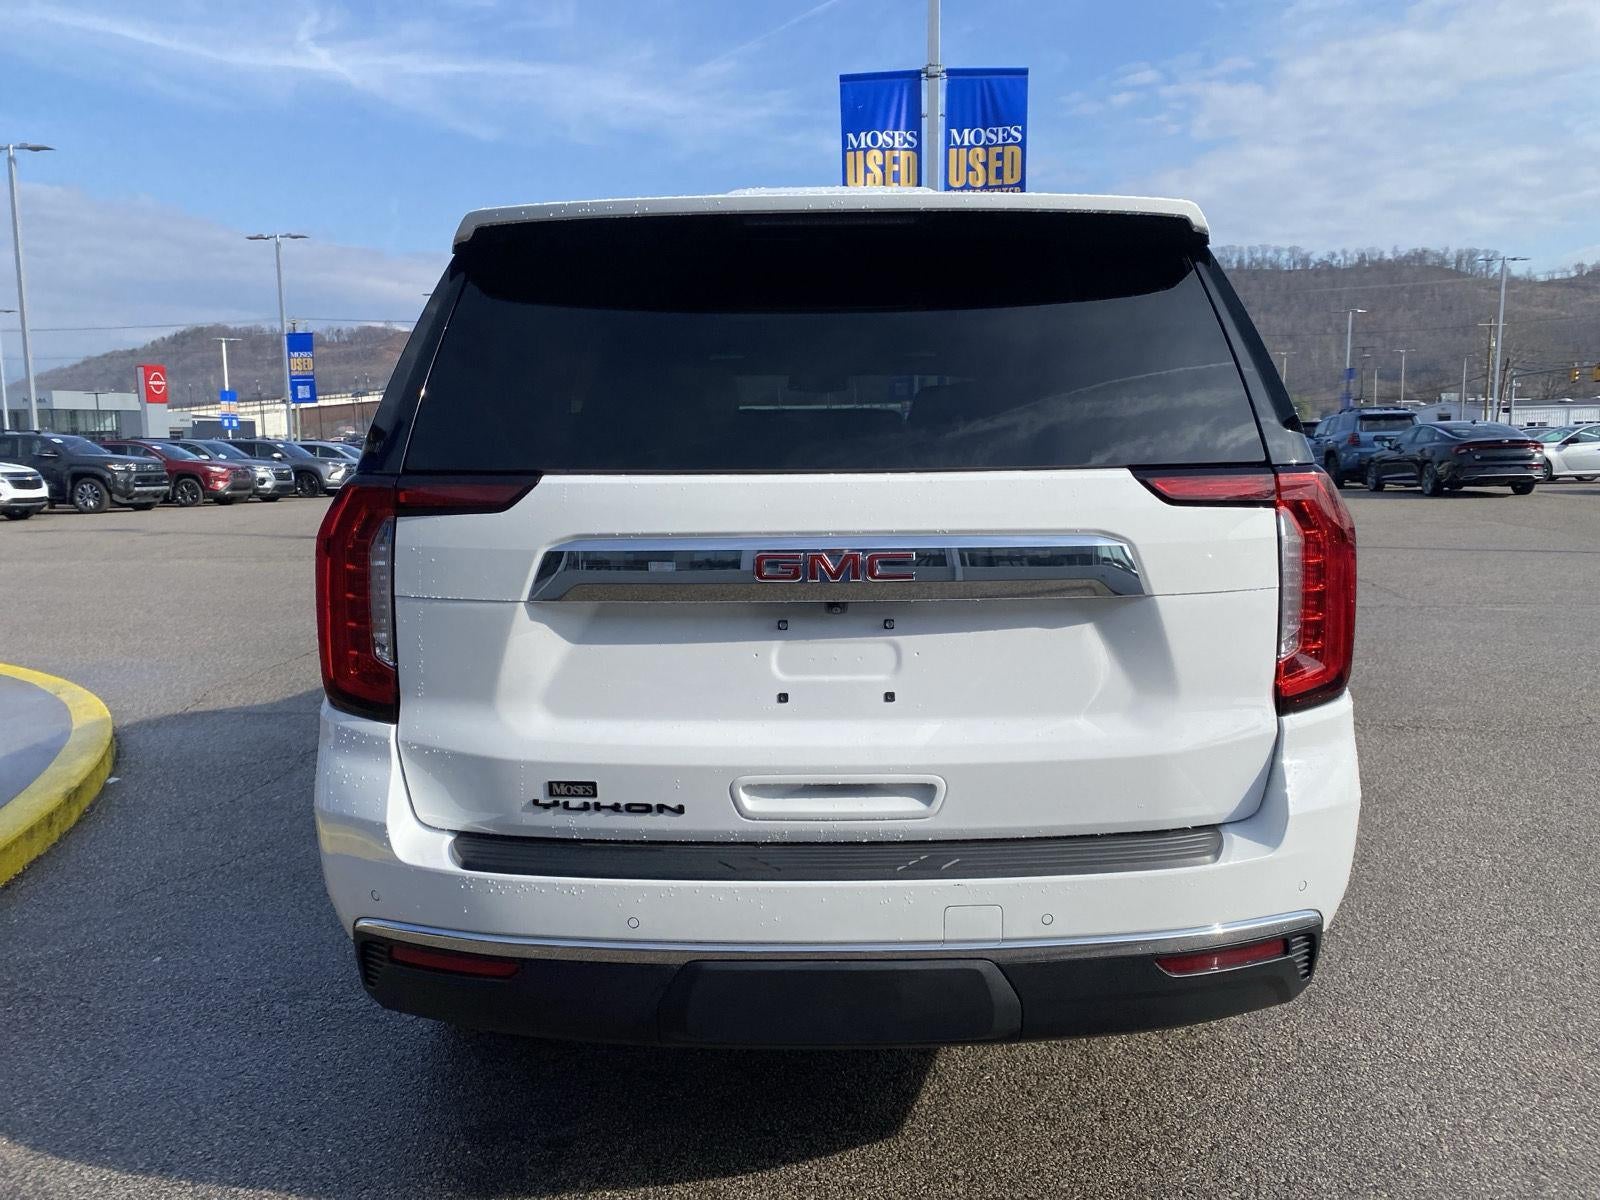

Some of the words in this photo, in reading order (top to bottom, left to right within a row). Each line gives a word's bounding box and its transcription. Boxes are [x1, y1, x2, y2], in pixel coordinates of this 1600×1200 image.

[847, 130, 917, 149] MOSES
[950, 125, 1022, 146] MOSES
[846, 150, 918, 187] USED
[948, 145, 1022, 188] USED
[290, 358, 313, 371] USED
[754, 552, 916, 583] GMC
[552, 783, 594, 795] MOSES
[532, 799, 685, 815] YUKON
